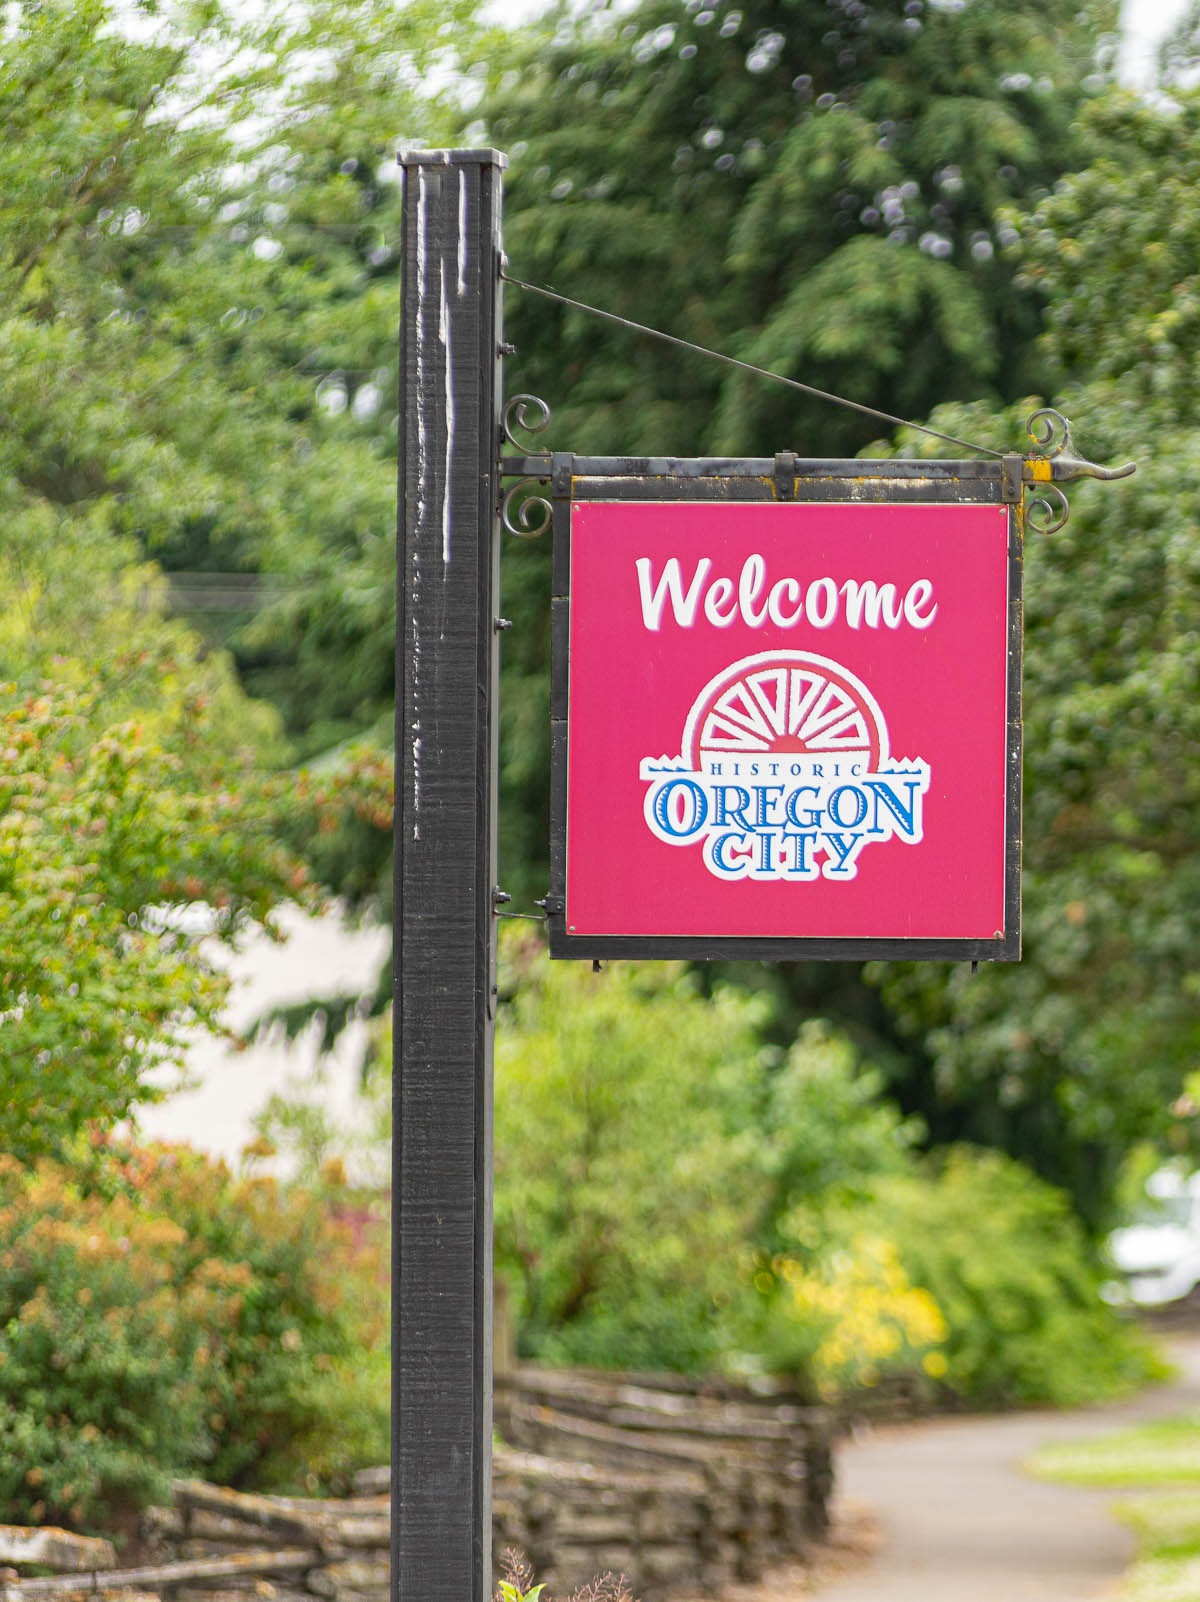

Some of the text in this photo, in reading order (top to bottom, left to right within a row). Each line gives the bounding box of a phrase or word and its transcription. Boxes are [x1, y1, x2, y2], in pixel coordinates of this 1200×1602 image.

[635, 553, 937, 631] Welcome
[710, 763, 863, 778] HISTORIC
[653, 778, 921, 837] OREGON
[711, 832, 864, 873] CITY
